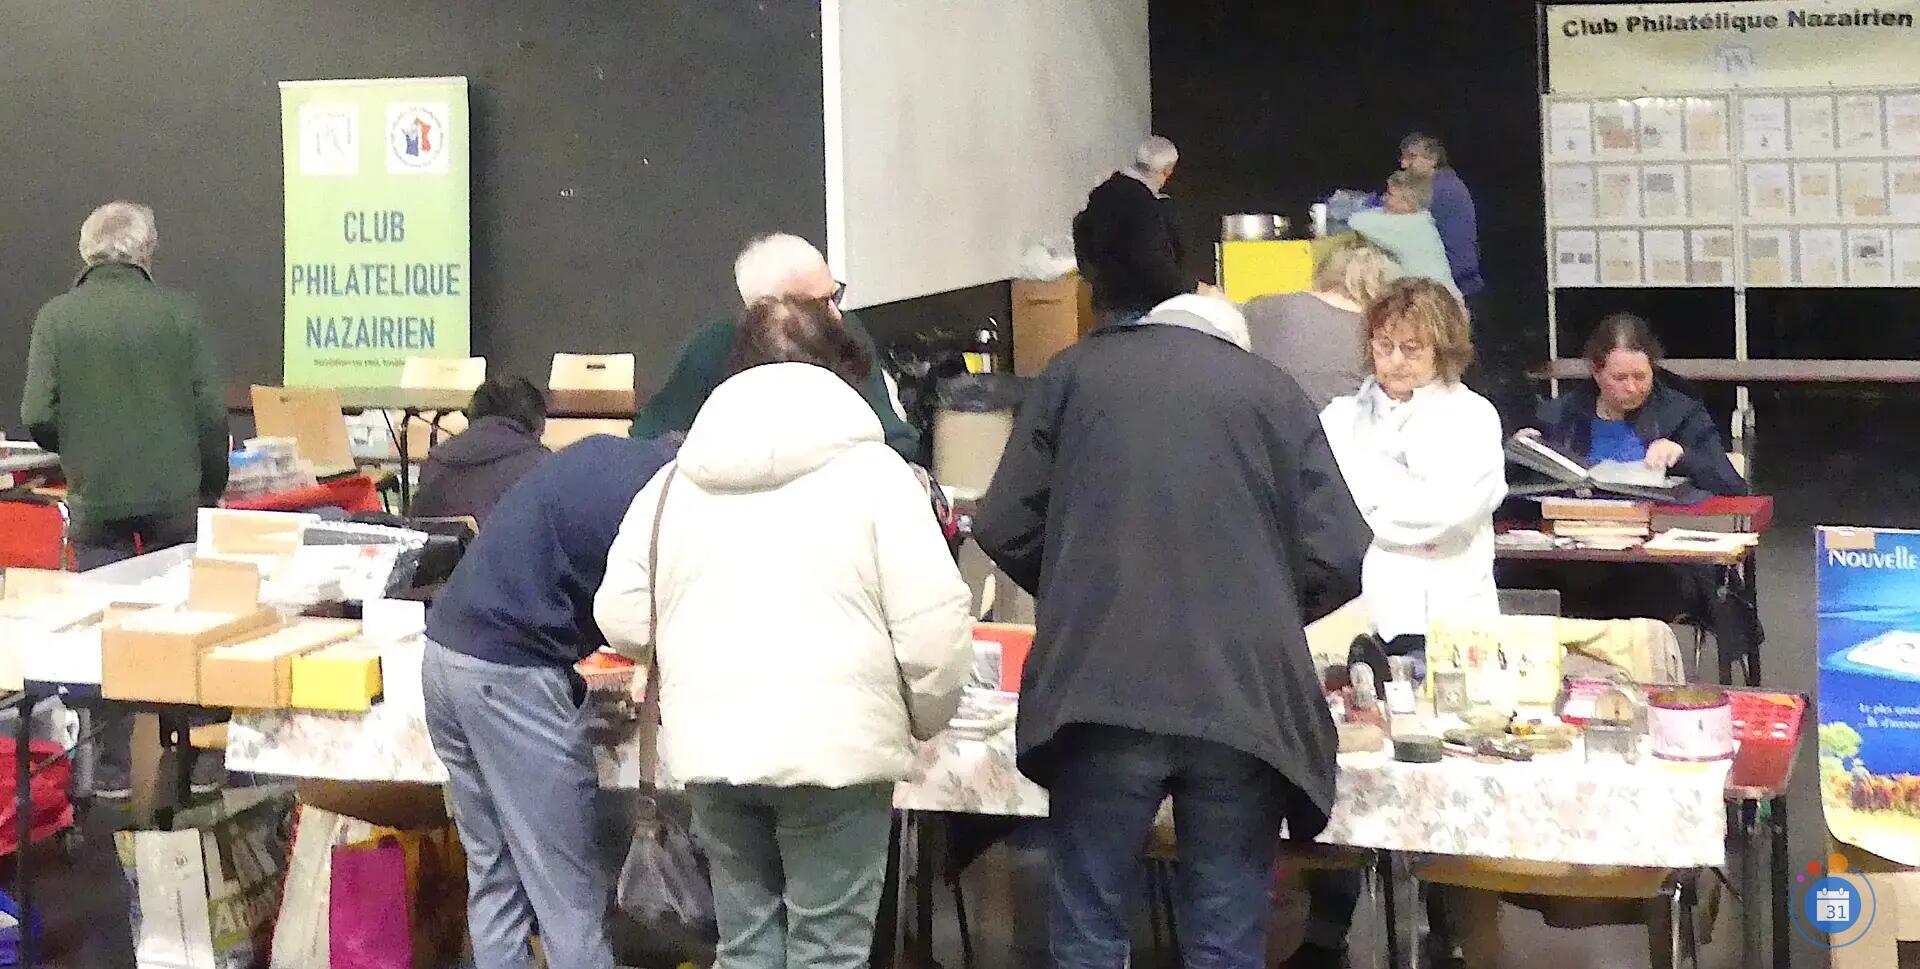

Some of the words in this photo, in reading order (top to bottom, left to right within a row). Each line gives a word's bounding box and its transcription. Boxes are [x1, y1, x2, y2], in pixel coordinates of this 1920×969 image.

[1562, 18, 1618, 37] Club
[1626, 11, 1778, 33] Philatélique
[1787, 8, 1914, 27] Nazairien
[343, 211, 405, 243] CLUB
[291, 263, 461, 297] PHILATELIQUE
[306, 315, 436, 349] NAZAIRIEN
